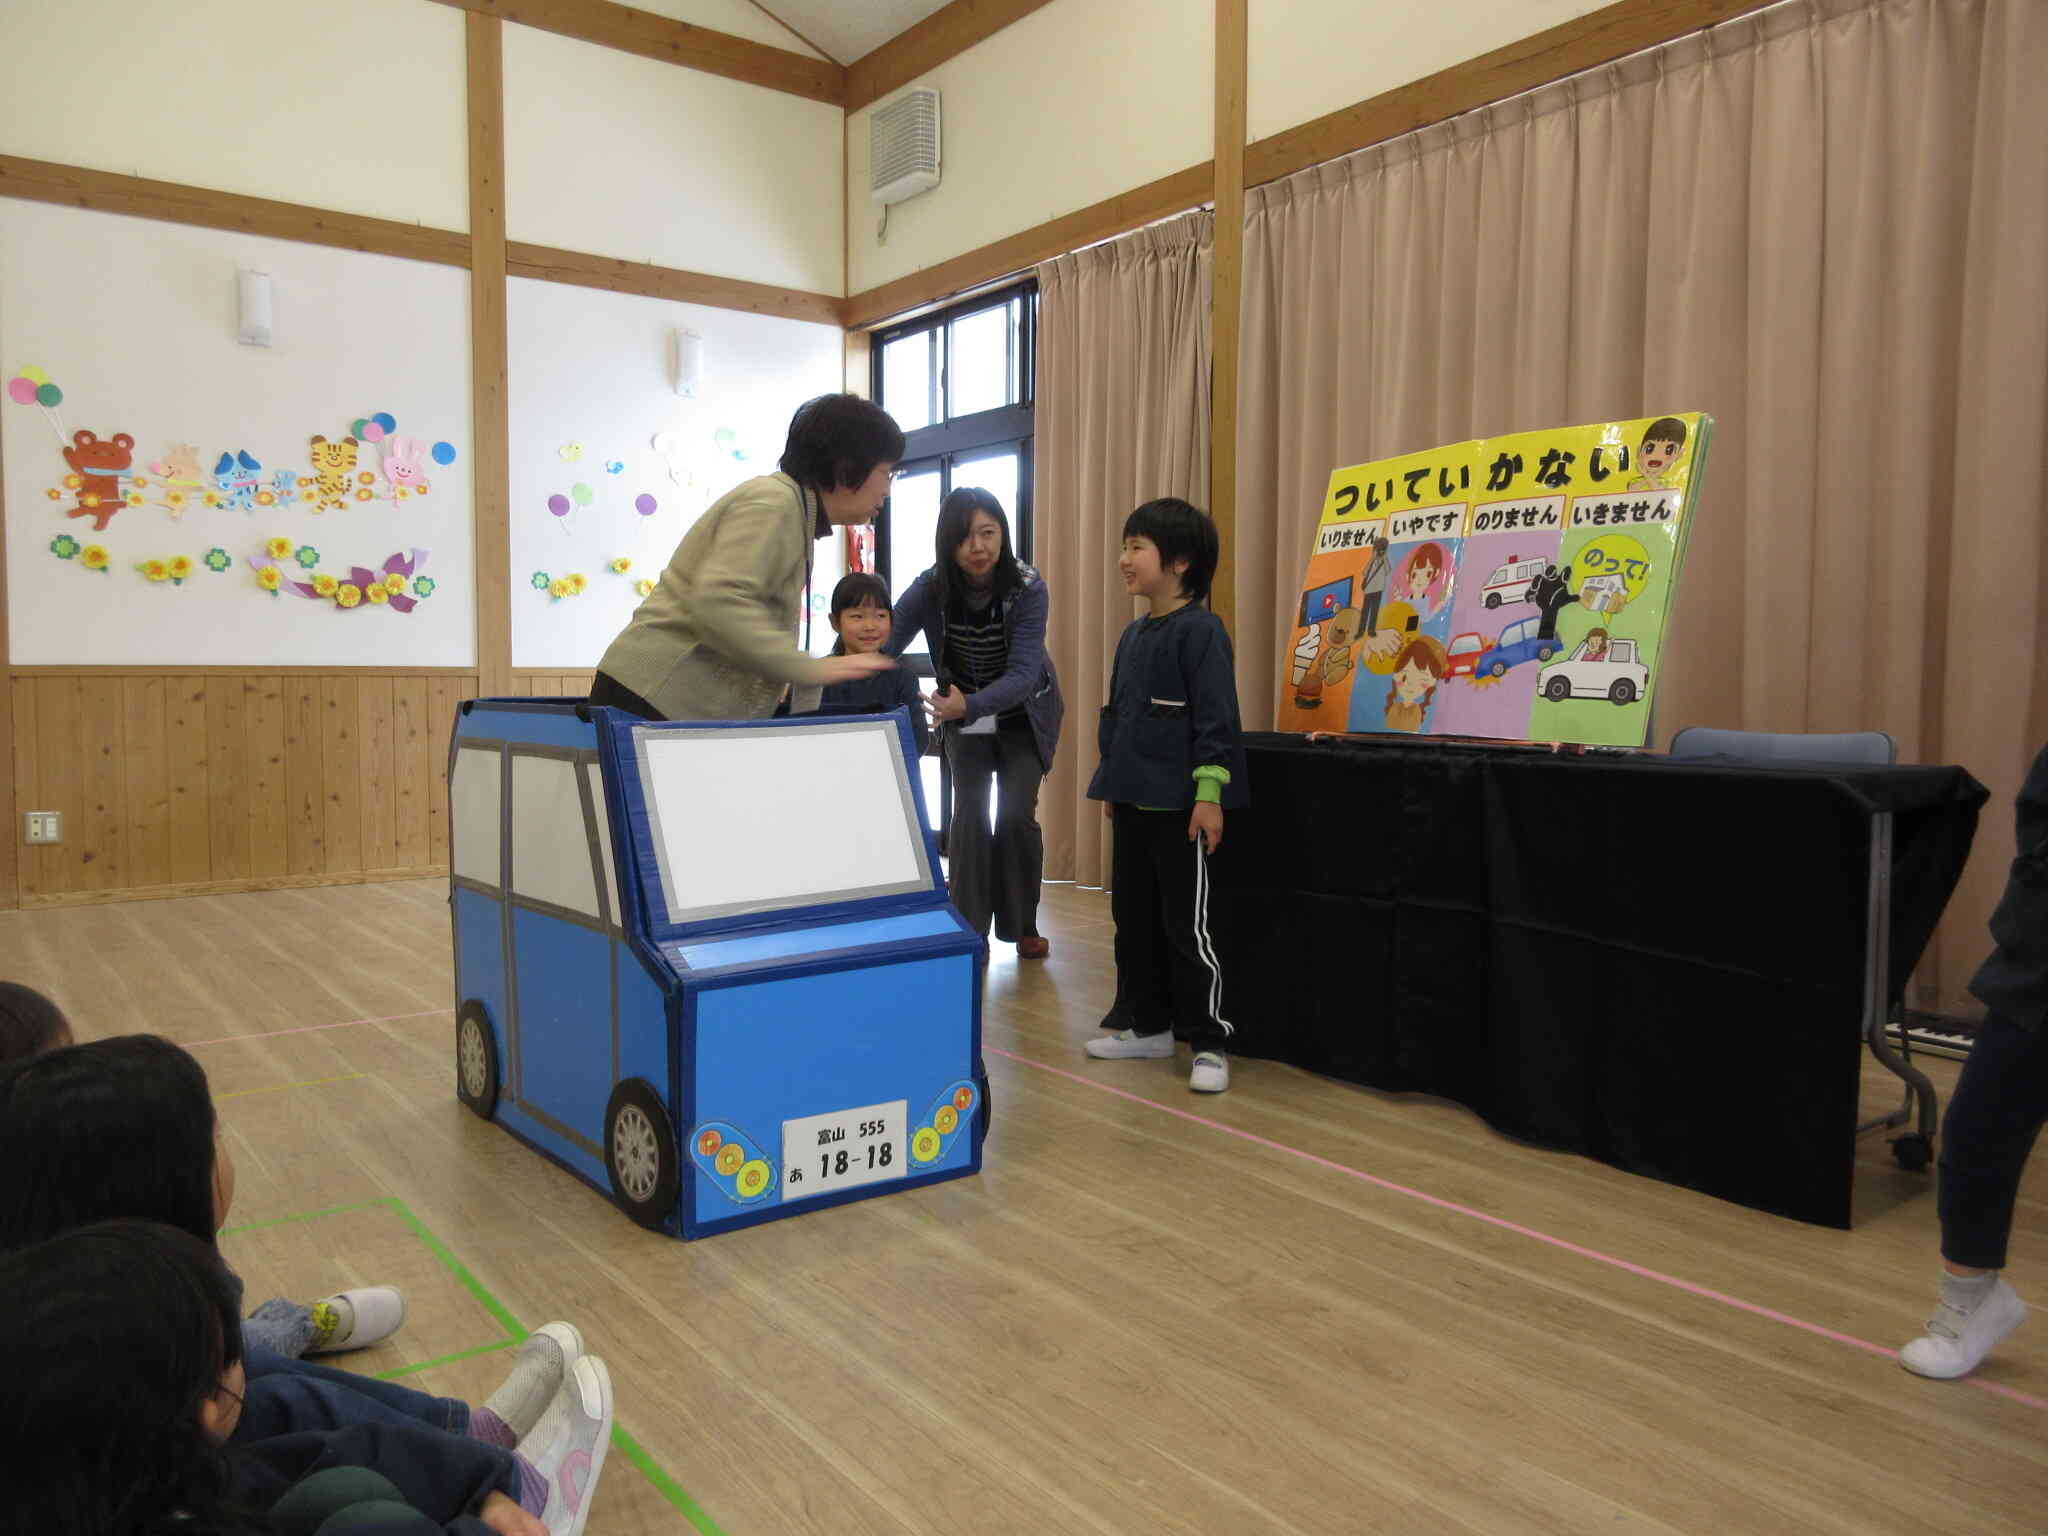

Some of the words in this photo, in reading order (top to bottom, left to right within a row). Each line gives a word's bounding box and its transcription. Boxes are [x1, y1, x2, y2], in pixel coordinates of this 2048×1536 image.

[1334, 448, 1630, 516] ついていかない
[1393, 512, 1459, 536] いやです
[1474, 504, 1558, 530] のりません
[1573, 502, 1671, 525] いきません
[1321, 527, 1377, 548] いりません
[818, 1127, 845, 1145] 富山
[859, 1120, 885, 1138] 555
[790, 1168, 803, 1183] あ
[821, 1142, 892, 1178] 18-18
